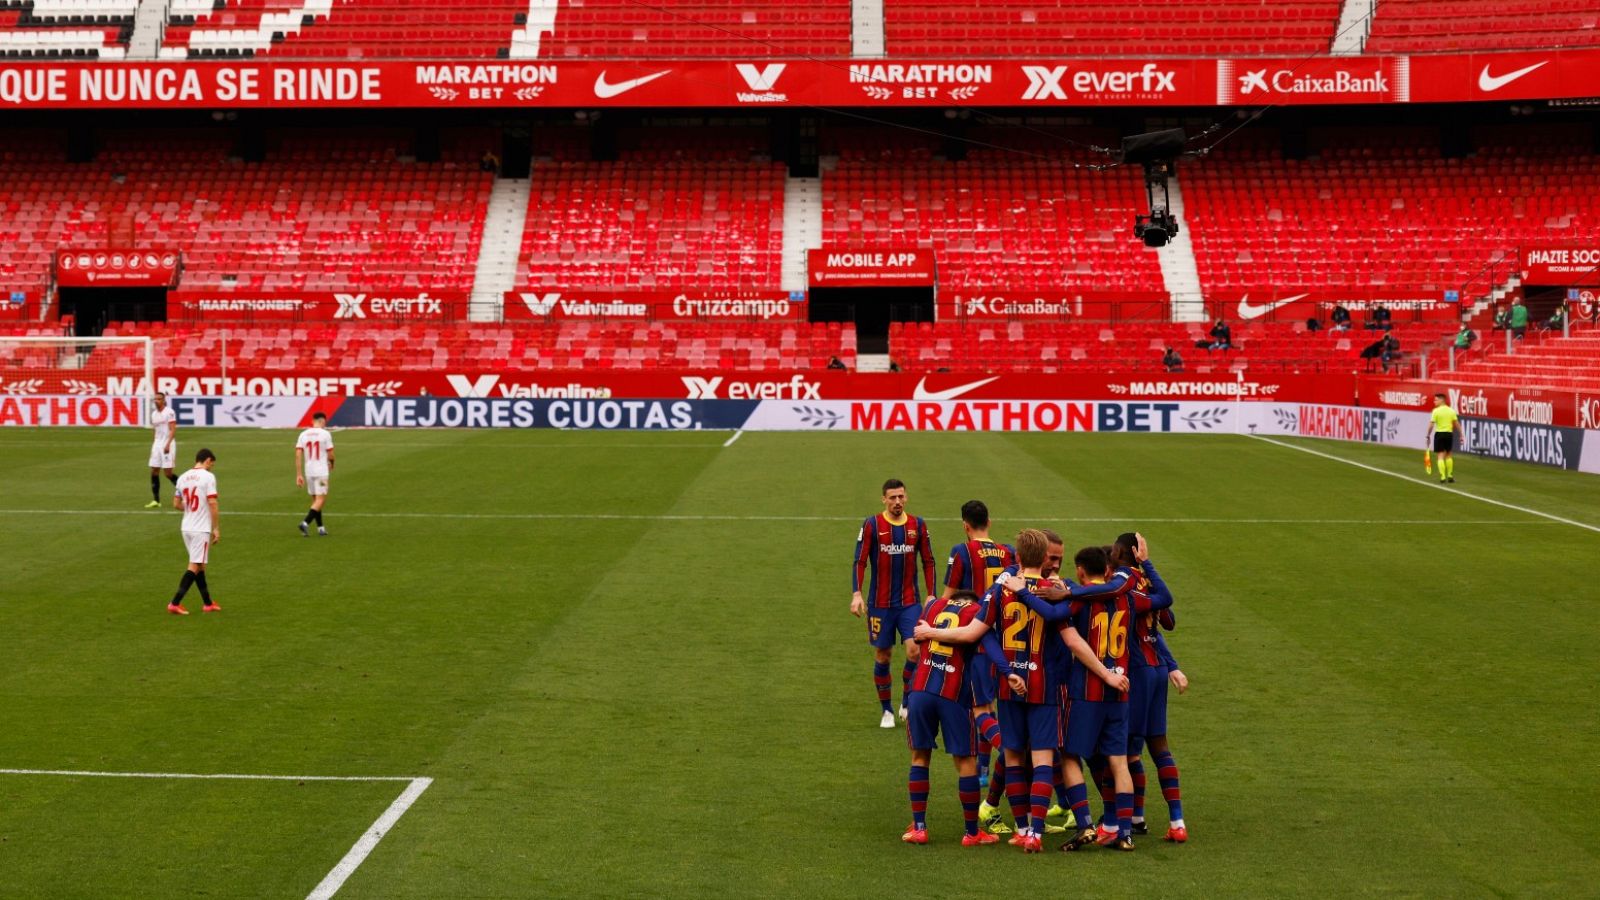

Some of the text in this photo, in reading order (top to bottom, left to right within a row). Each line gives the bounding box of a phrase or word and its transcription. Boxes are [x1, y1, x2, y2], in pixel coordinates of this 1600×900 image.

[416, 65, 557, 84] MARATHON
[850, 65, 992, 83] MARATHON
[1073, 64, 1176, 92] everfx
[1272, 69, 1389, 93] CaixaBank
[1, 68, 381, 103] QUE NUNCA SE RINDE
[469, 88, 504, 100] BET
[903, 86, 938, 99] BET
[827, 253, 916, 267] MOBILE APP
[199, 299, 303, 310] MARATHONBET
[371, 292, 441, 313] everfx
[560, 300, 647, 315] Valvoline
[673, 294, 790, 319] Cruzcampo
[989, 297, 1072, 314] CaixaBank
[106, 377, 361, 396] MARATHONBET
[728, 375, 821, 400] everfx
[1130, 382, 1259, 395] MARATHONBET
[0, 397, 222, 425] ATHONET
[364, 400, 702, 430] MEJORES CUOTAS,
[851, 402, 1180, 432] MARATHONBET
[1299, 405, 1386, 442] MARATHONBET
[306, 440, 320, 460] 11
[1461, 419, 1567, 470] MEJORES CUOTAS,
[182, 486, 200, 512] 16
[880, 543, 914, 553] Rakuten
[870, 617, 881, 632] 15
[1003, 601, 1045, 655] 21
[1091, 610, 1127, 659] 16
